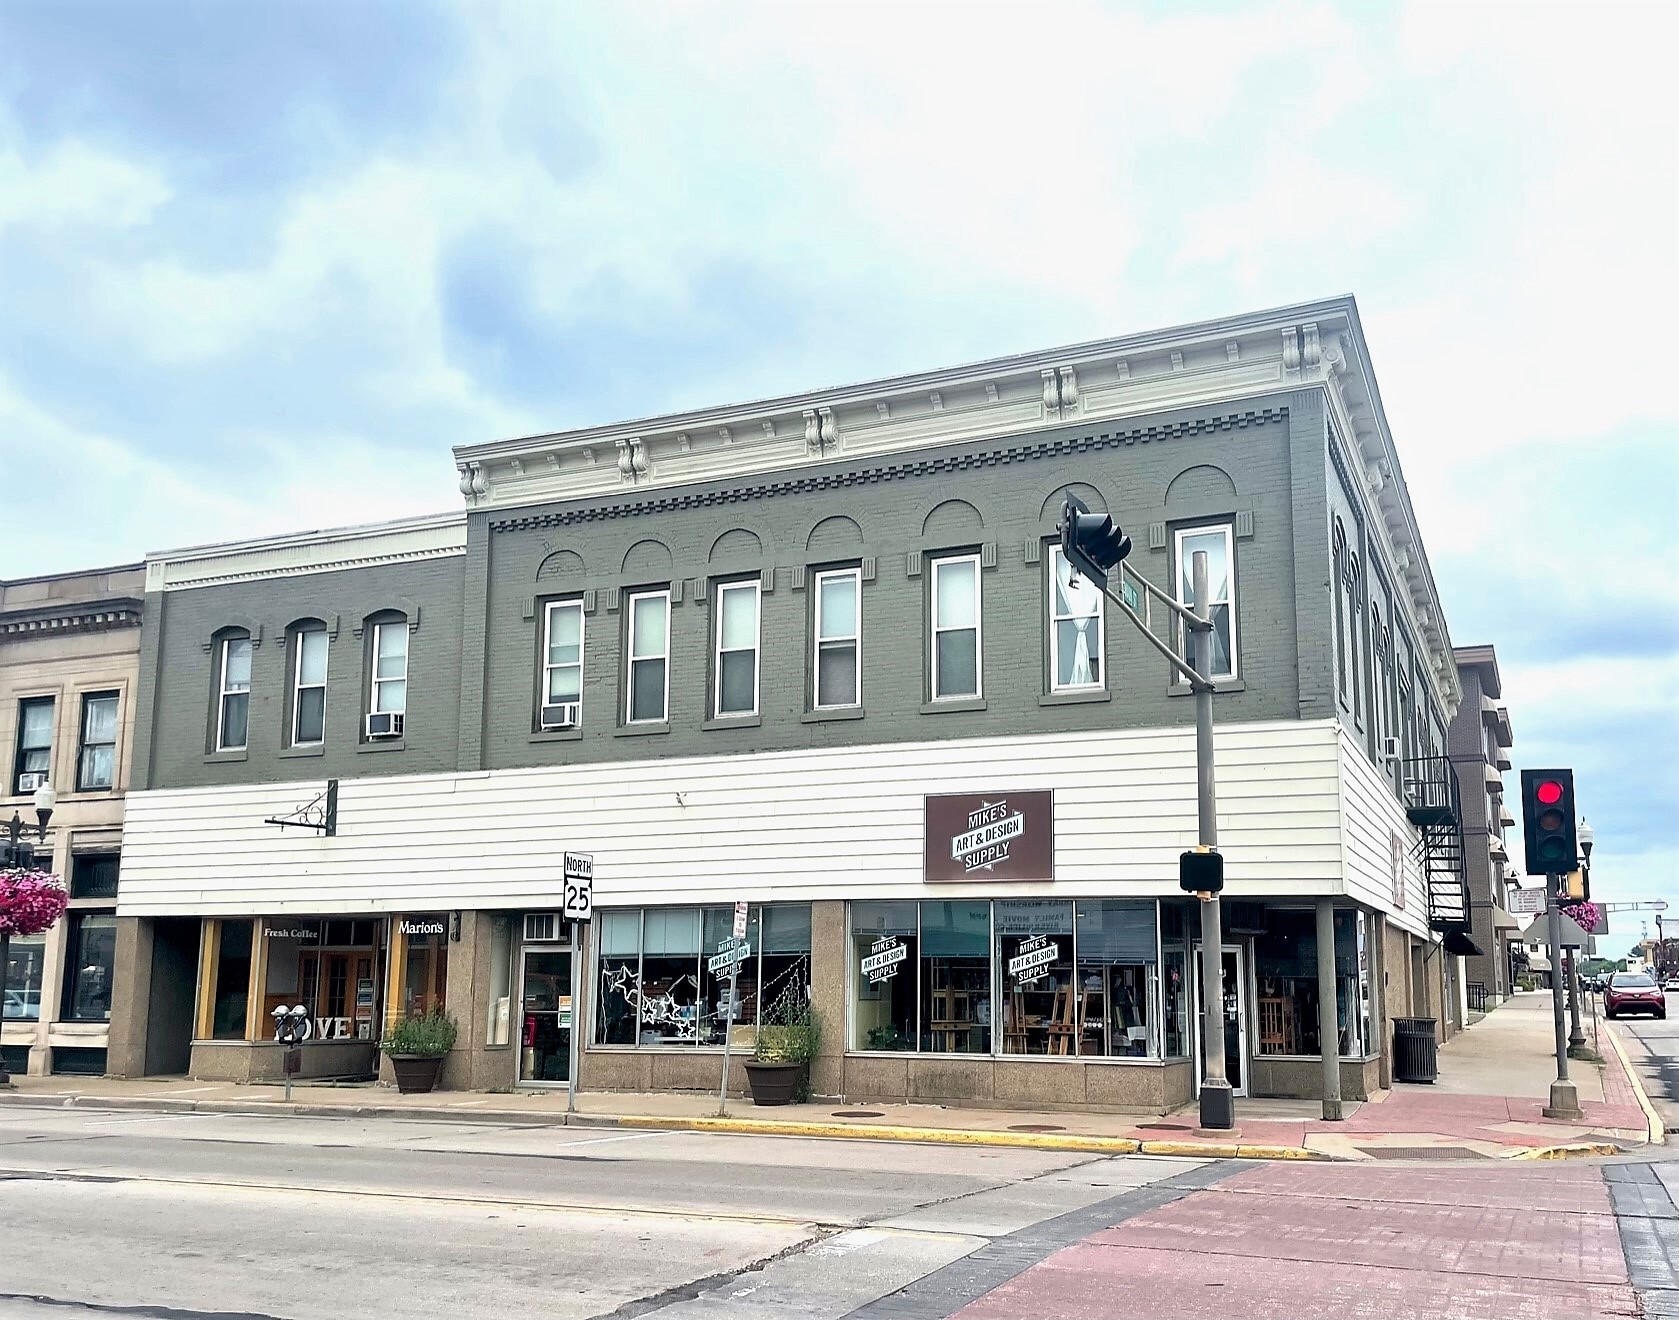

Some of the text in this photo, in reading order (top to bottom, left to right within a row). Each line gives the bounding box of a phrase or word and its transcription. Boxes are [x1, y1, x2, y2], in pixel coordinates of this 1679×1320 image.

[968, 804, 1007, 829] MIKE'S
[956, 818, 1019, 853] ART & DESIGN
[965, 841, 1010, 868] SUPPLY
[566, 855, 592, 874] NORTH
[566, 885, 589, 911] 25
[264, 927, 318, 938] Fresh Coffee
[397, 920, 444, 934] Marion's
[871, 938, 897, 955] MIKE'S
[1019, 937, 1047, 954] MIKE'S
[710, 955, 723, 969] ART
[722, 955, 728, 964] &
[863, 948, 905, 970] ART & DESIGN
[1011, 947, 1056, 970] ART & DESIGN
[869, 962, 898, 981] SUPPLY
[1018, 962, 1049, 981] SUPPLY
